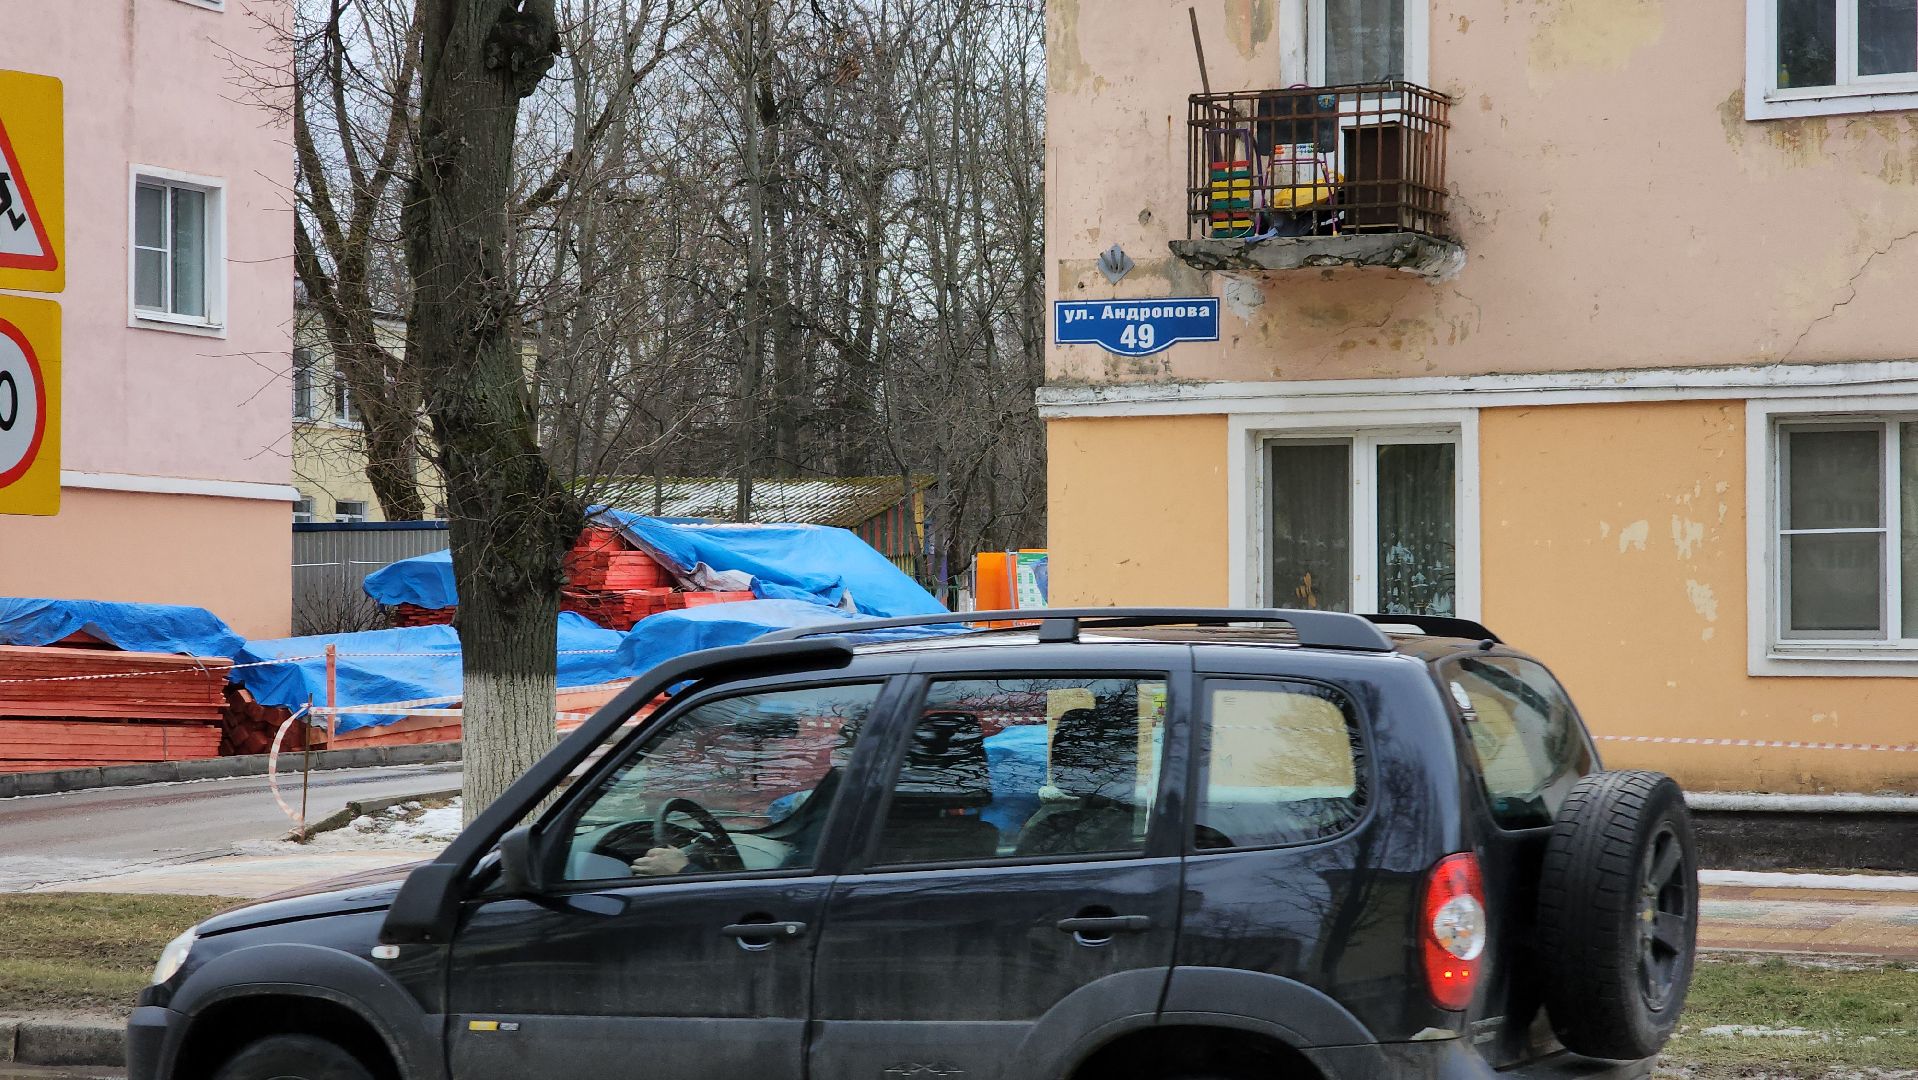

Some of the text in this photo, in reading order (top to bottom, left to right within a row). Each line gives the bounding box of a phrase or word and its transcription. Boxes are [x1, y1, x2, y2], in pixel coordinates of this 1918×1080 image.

[1064, 305, 1210, 323] ул. Андропова
[1120, 323, 1155, 349] 49
